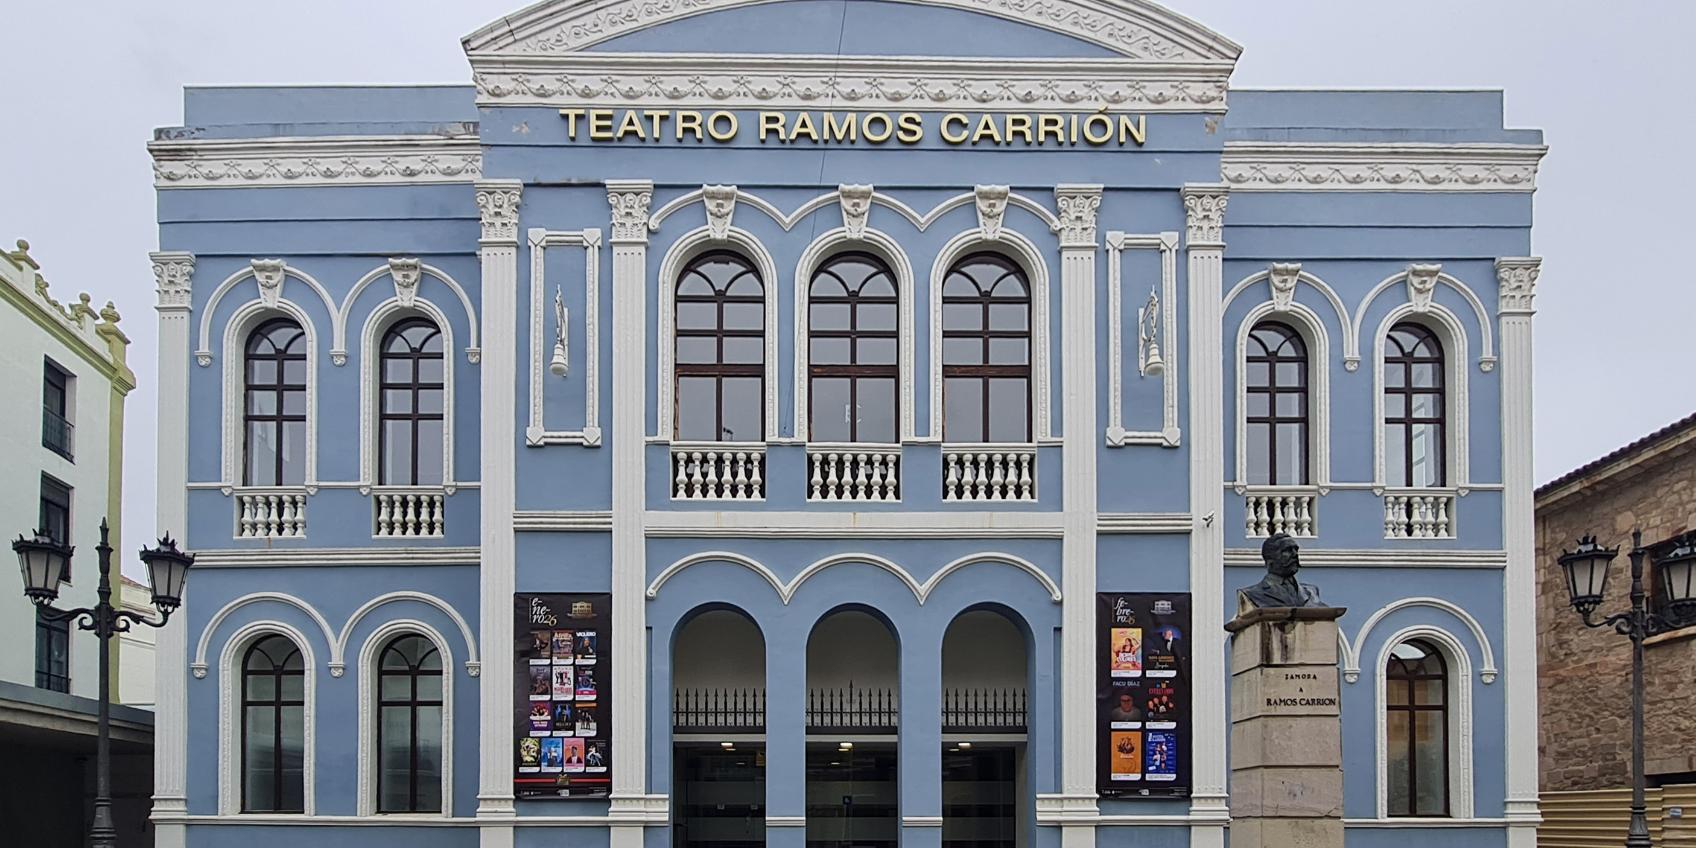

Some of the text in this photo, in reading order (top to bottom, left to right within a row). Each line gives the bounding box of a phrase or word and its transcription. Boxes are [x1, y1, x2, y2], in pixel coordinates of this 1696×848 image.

[559, 106, 1147, 145] TEATRO RAMOS CARRIÓN
[1266, 698, 1336, 706] RAMOS CARRION
